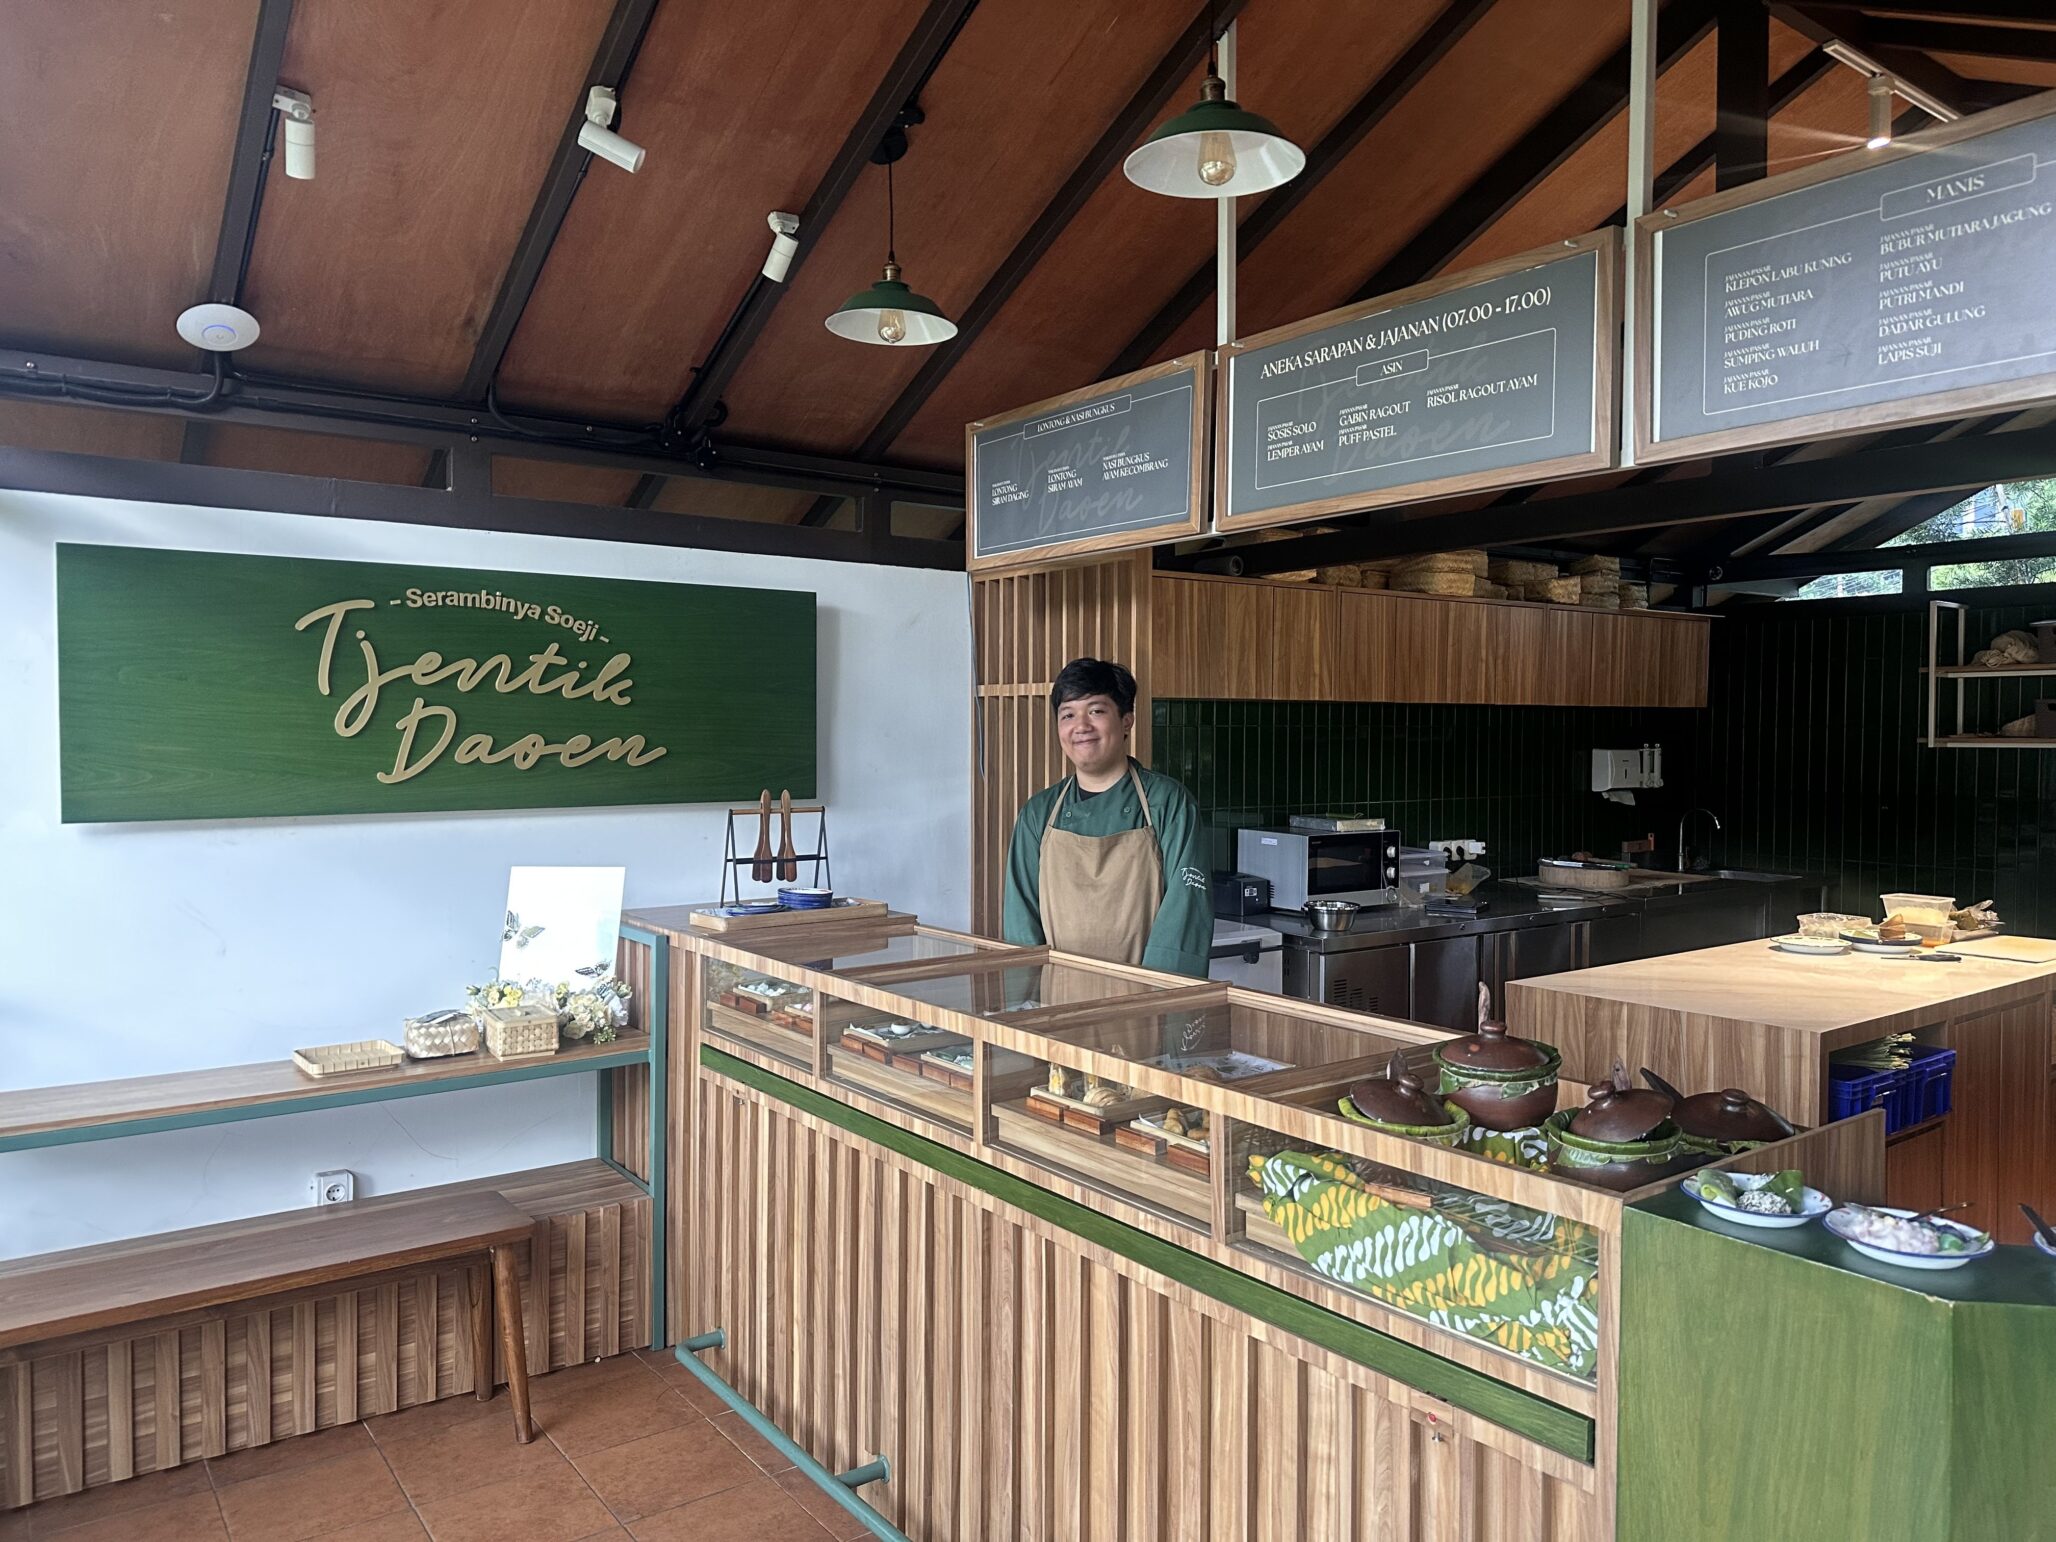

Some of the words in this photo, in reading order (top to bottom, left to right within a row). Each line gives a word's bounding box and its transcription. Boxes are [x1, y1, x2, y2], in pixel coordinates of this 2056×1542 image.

[1926, 174, 1984, 203] MANIS
[1880, 234, 1925, 255] BUBUR
[1927, 218, 1990, 243] MUTIARA
[1990, 202, 2052, 230] JAGUNG
[1726, 275, 1770, 292] KLEPON
[1772, 265, 1802, 282] LABU
[1804, 252, 1852, 274] KUNING
[1880, 264, 1914, 282] PUTU
[1916, 257, 1942, 274] AYU
[1725, 302, 1759, 318] AWUG
[1761, 288, 1814, 310] MUTIARA
[1880, 292, 1916, 310] PUTRI
[1919, 281, 1964, 301] MANDI
[1260, 354, 1302, 379] ANEKA
[1304, 337, 1363, 367] SARAPAN
[1366, 334, 1376, 350] &
[1378, 316, 1439, 349] JAJANAN
[1442, 302, 1492, 332] (07.00
[1505, 286, 1551, 314] 17.00)
[1725, 325, 1768, 344] PUDING
[1769, 318, 1796, 334] ROTI
[1879, 319, 1924, 337] DADAR
[1926, 305, 1986, 327] GULUNG
[1724, 350, 1775, 368] SUMPING
[1777, 340, 1820, 358] WALUH
[1878, 347, 1914, 365] LAPIS
[1916, 342, 1942, 357] SUJI
[1380, 360, 1402, 376] ASIN
[1427, 392, 1458, 408] RISOL
[1460, 380, 1506, 401] RAGOUT
[1506, 374, 1538, 392] AYAM
[1724, 382, 1746, 394] KUE
[1748, 374, 1778, 390] KOJO
[1037, 418, 1065, 432] LONTONG
[1340, 410, 1368, 426] GABIN
[1370, 401, 1411, 420] RAGOUT
[1268, 426, 1292, 441] SOSIS
[1292, 422, 1316, 436] SOLO
[1339, 432, 1361, 446] PUFF
[1363, 425, 1397, 442] PASTEL
[1103, 459, 1117, 470] NASI
[1118, 452, 1150, 466] BUNGKUS
[1268, 446, 1300, 461] LEMPER
[1300, 440, 1324, 454] AYAM
[1048, 470, 1076, 484] LONTONG
[1120, 458, 1168, 477] KECOMBRANG
[992, 484, 1018, 496] LONTONG
[1048, 482, 1066, 493] SIRAM
[406, 588, 542, 620] Serambinya
[544, 606, 600, 642] Soeji
[295, 600, 633, 738] Tjentik
[376, 697, 668, 784] Daoen
